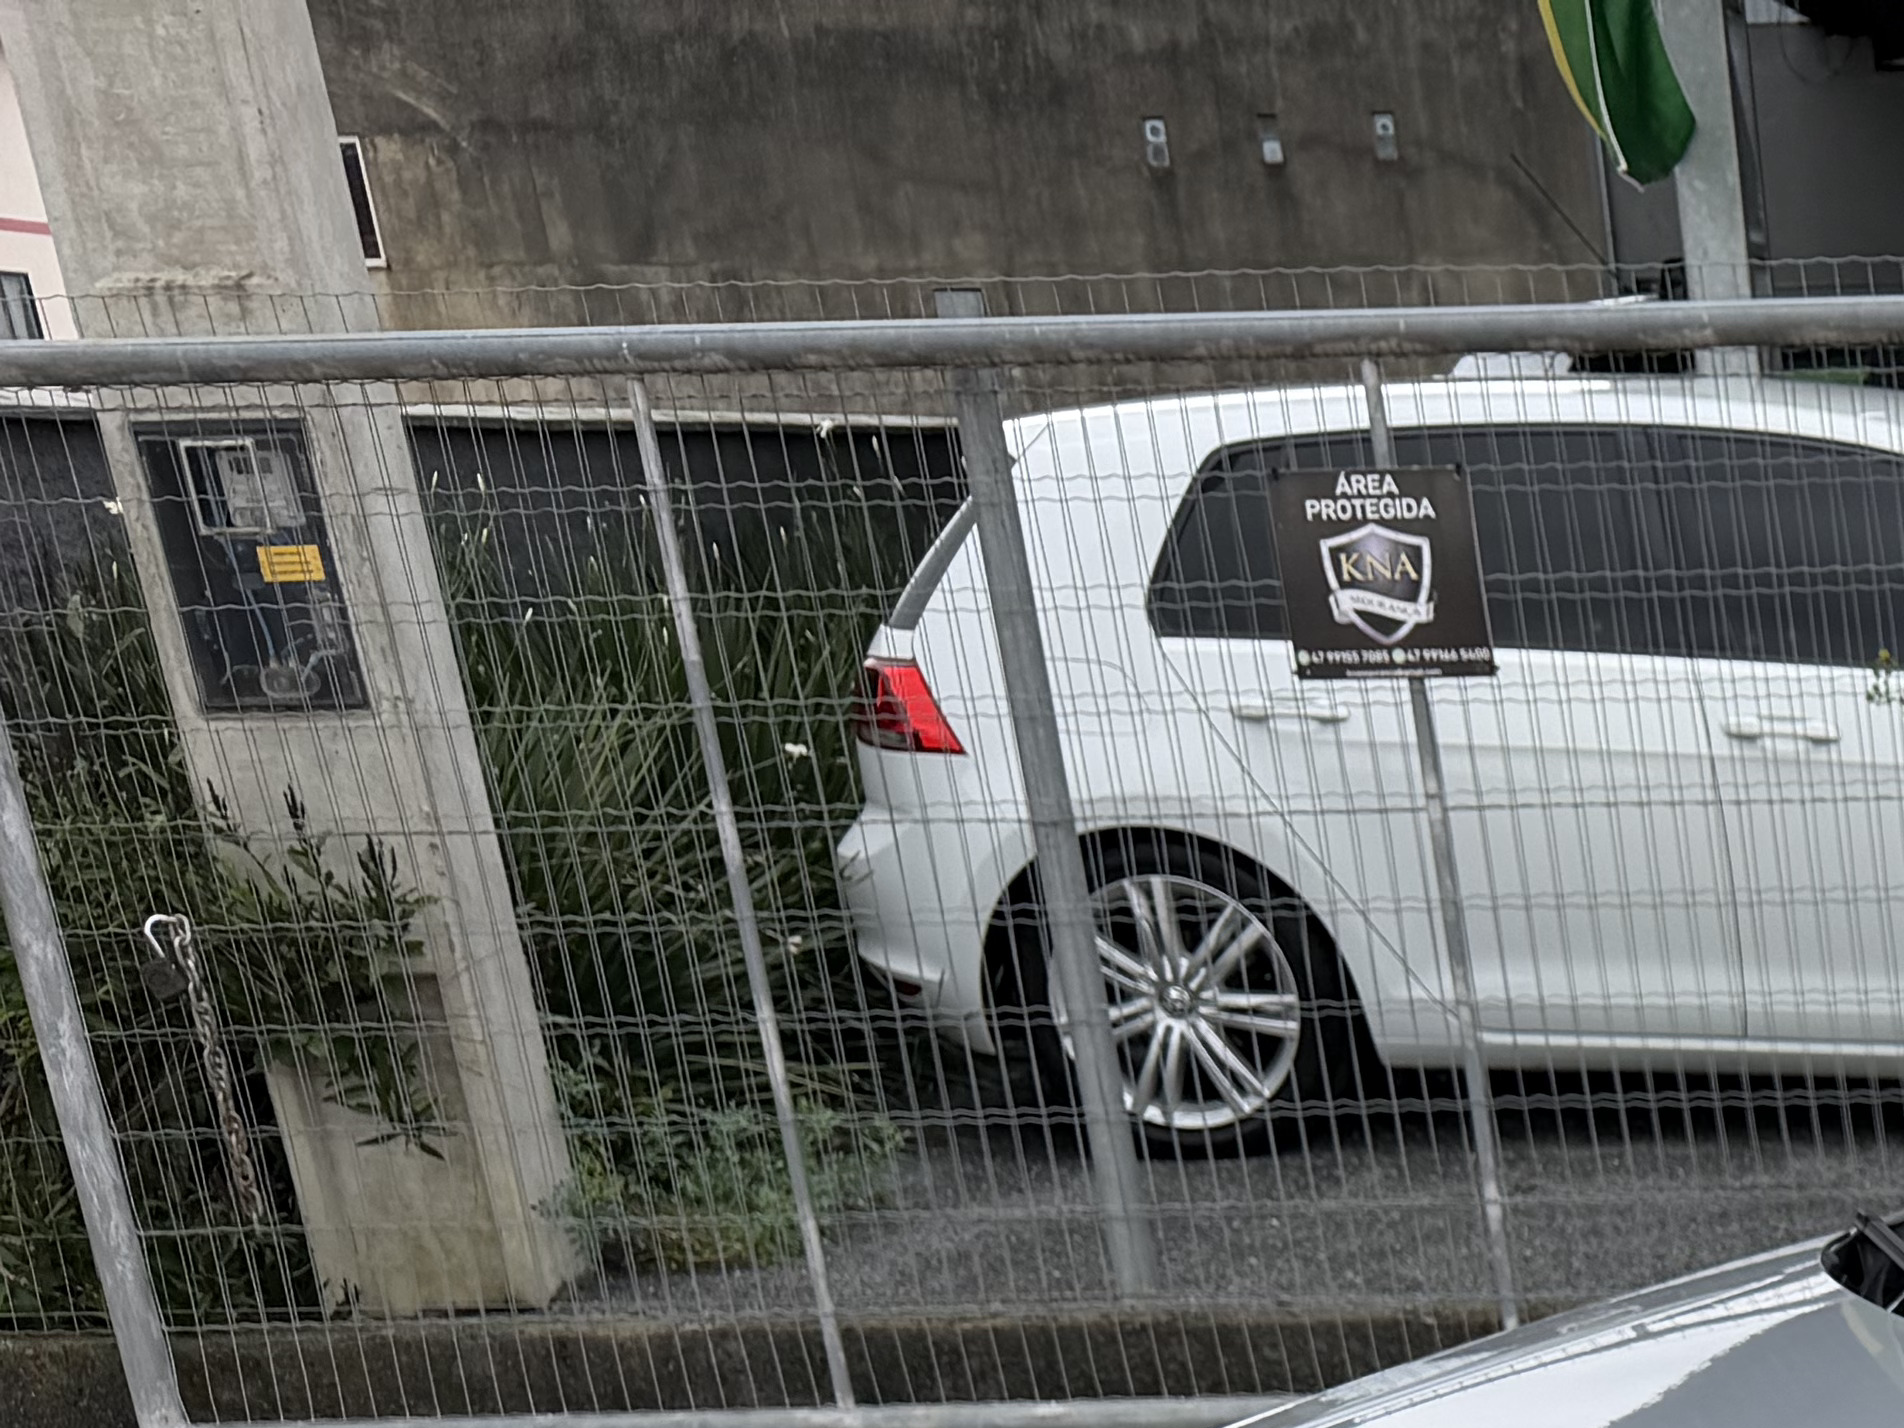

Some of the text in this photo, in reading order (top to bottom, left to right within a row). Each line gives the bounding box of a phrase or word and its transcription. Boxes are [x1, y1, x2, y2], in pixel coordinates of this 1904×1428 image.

[1335, 470, 1400, 496] ÁREA
[1305, 497, 1437, 521] PROTEGIDA
[1339, 552, 1419, 582] KNA
